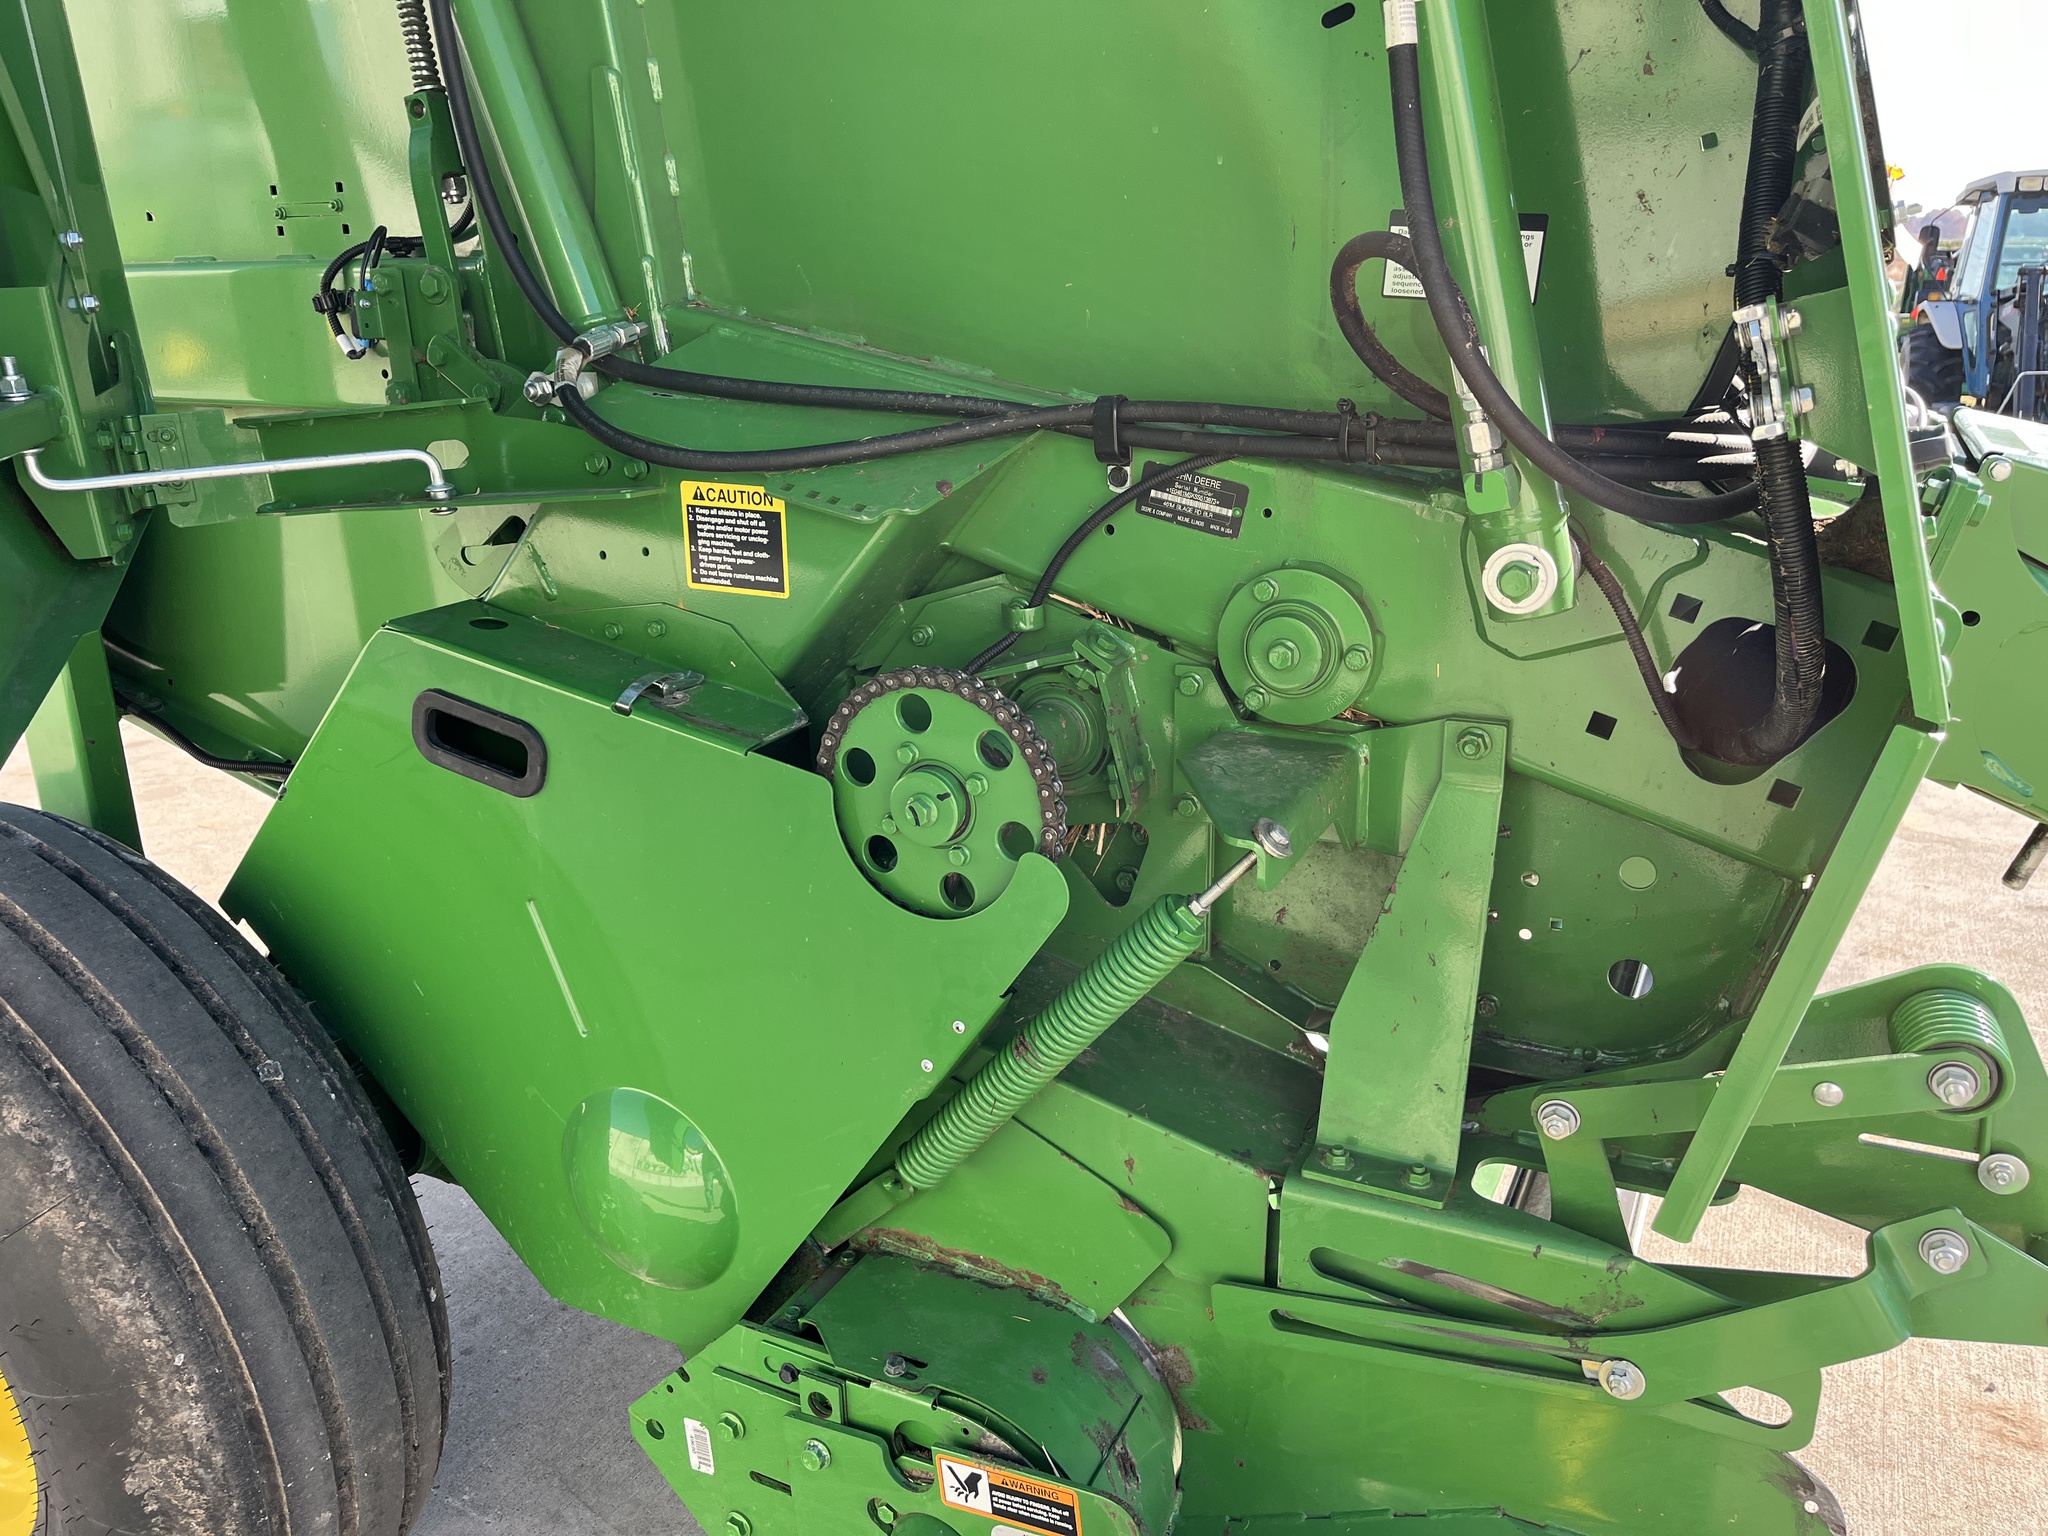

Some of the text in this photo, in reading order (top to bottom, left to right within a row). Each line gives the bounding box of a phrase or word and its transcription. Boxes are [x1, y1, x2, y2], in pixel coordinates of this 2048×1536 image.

[1390, 287, 1424, 295] loosened
[1194, 475, 1222, 490] DEERE
[1174, 481, 1214, 497] Serial Number
[706, 488, 774, 507] CAUTION
[695, 507, 710, 516] Keep
[717, 509, 738, 517] shields
[745, 511, 762, 519] place.
[1156, 509, 1173, 518] COMPANY
[695, 515, 725, 524] Disengage
[696, 523, 715, 531] engine
[751, 528, 769, 536] power
[697, 530, 715, 538] before
[716, 533, 741, 542] servicing
[748, 536, 770, 545] unclog-
[711, 540, 736, 548] machine.
[698, 545, 712, 554] Keep
[712, 547, 732, 556] hands,
[708, 555, 722, 563] away
[699, 561, 717, 569] driven
[700, 577, 732, 586] unattended.
[733, 573, 755, 582] running
[755, 575, 779, 583] machine
[1009, 1478, 1060, 1500] WARNING
